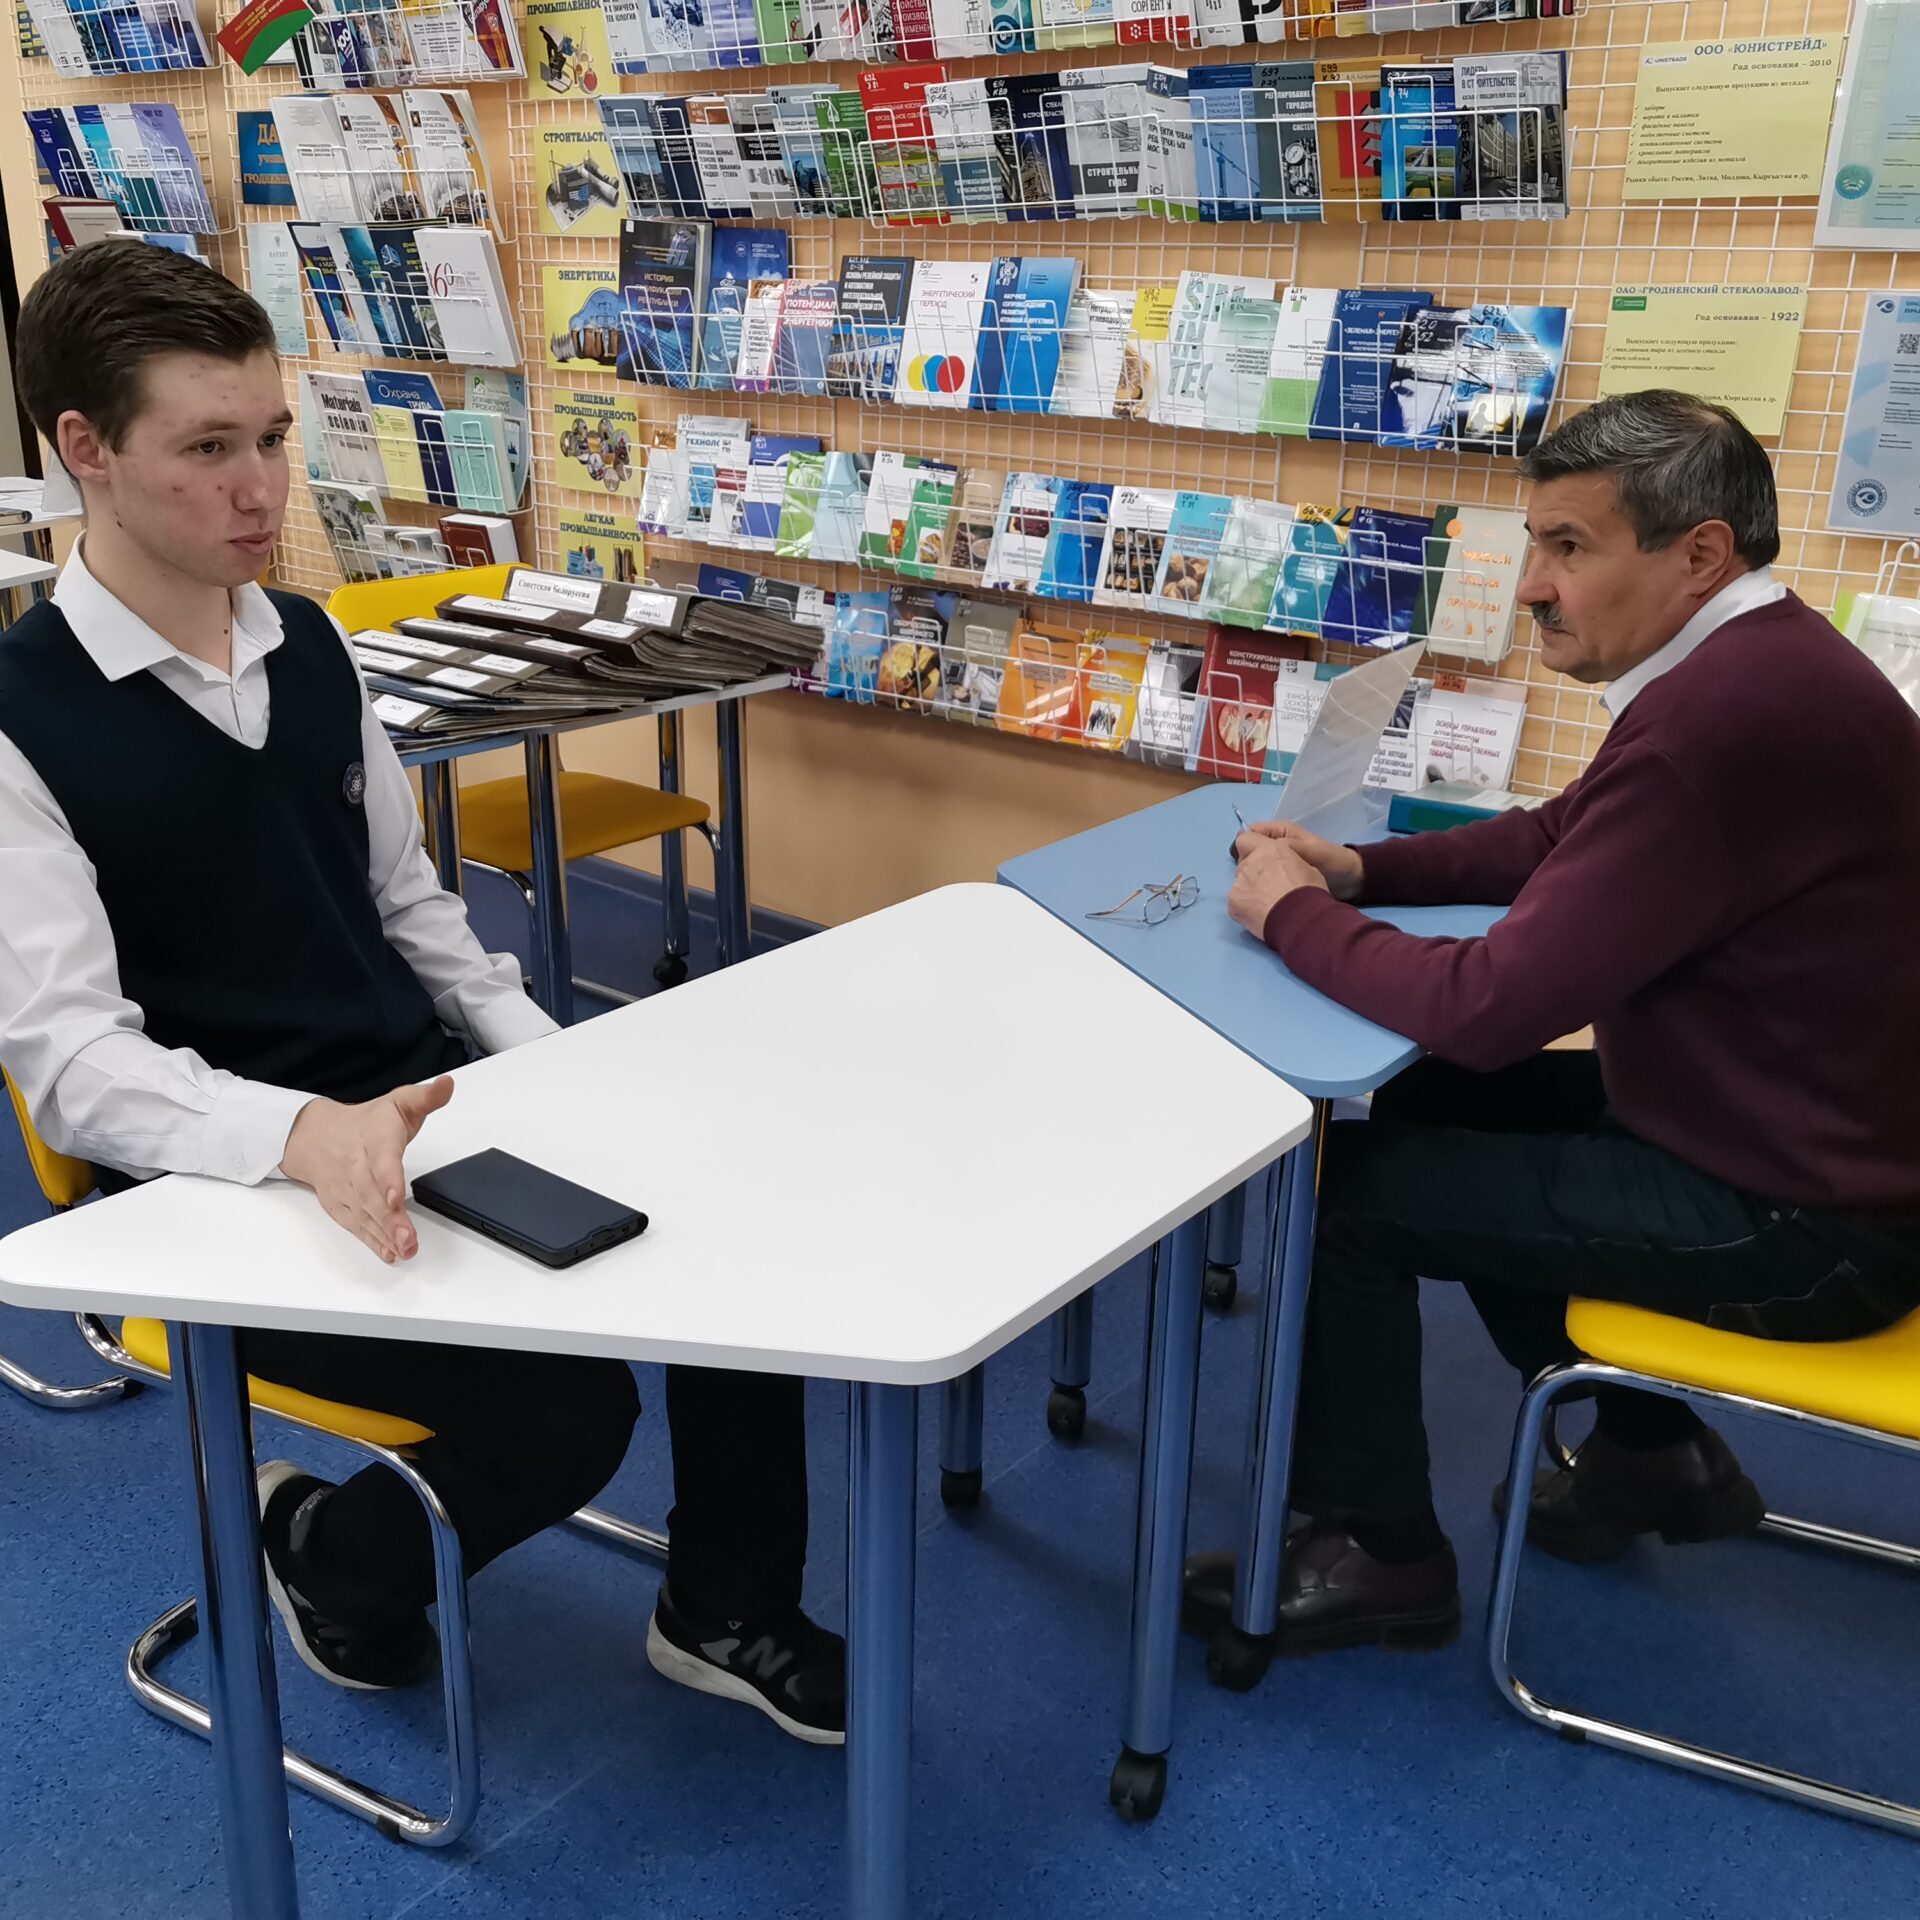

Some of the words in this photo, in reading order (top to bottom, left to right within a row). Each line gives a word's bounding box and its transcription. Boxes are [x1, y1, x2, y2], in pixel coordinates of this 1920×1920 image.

[1694, 44, 1724, 56] ООО
[1728, 37, 1827, 54] «ЮНИСТРЕЙД»
[1732, 63, 1748, 71] Год
[1751, 61, 1799, 70] основания
[1810, 59, 1832, 67] 2010
[1466, 76, 1516, 89] СТОИТЕЛЬСТВЕ
[1147, 144, 1169, 156] МОСОВ
[558, 270, 617, 282] ЭНЕРГЕТИКА
[1615, 286, 1636, 294] ОАО
[1695, 314, 1710, 322] Год
[1770, 311, 1799, 321] 1922
[378, 384, 421, 400] Охрана
[321, 393, 362, 413] Materials
[573, 393, 615, 406] ПИЩЕВАЯ
[554, 404, 637, 421] ПРОМЫШЛЕННОСТЬ
[584, 513, 615, 525] ЛЕГКАЯ
[560, 522, 641, 541] ПРОМЫШЛЕННОСТЬ
[518, 579, 551, 592] Советская
[552, 585, 591, 599] Белоруссия
[1461, 724, 1497, 737] УПРАВЛЕНИЯ
